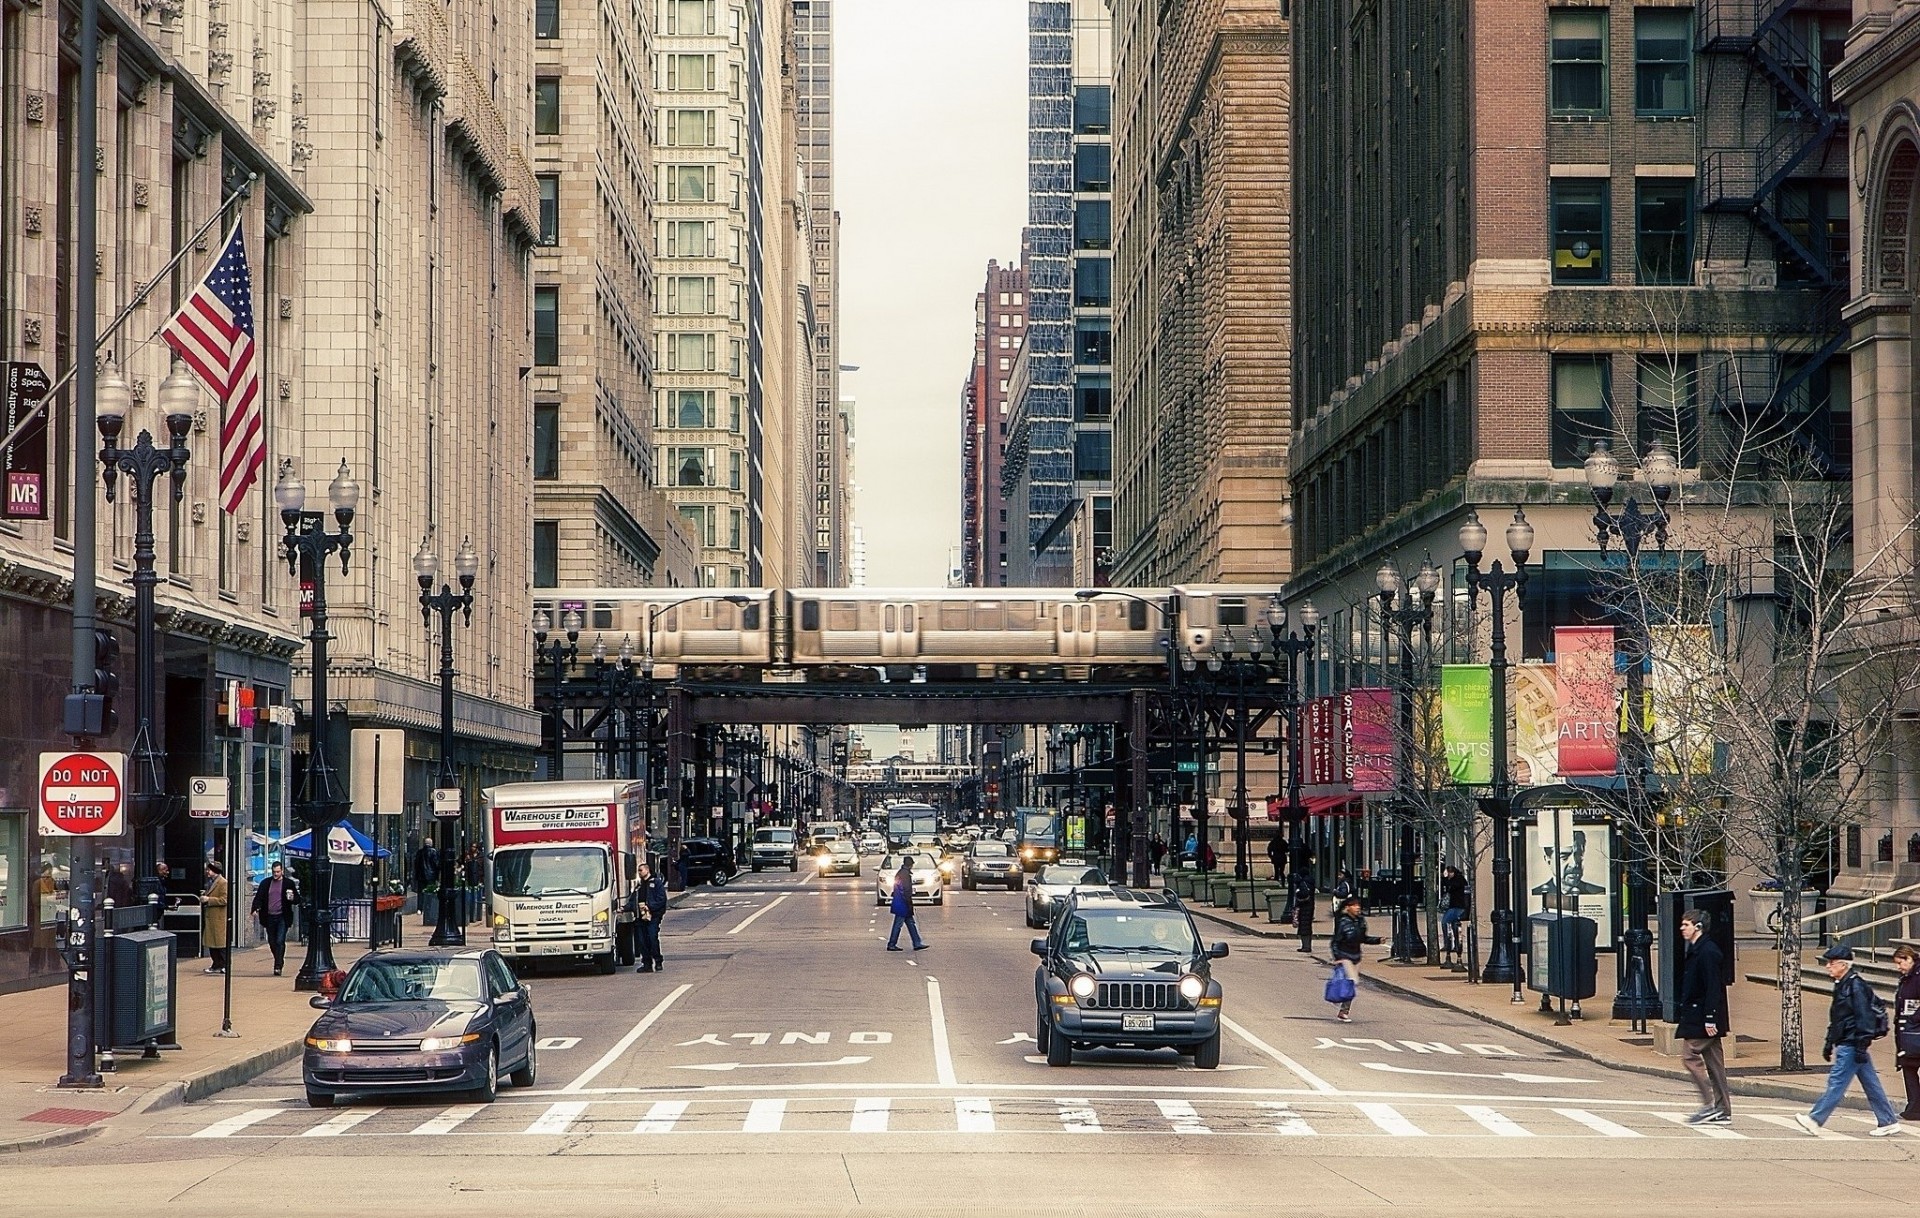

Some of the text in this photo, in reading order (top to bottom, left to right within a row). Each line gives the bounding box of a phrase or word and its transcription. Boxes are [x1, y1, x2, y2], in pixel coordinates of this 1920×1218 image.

[6, 367, 18, 470] www.arcrealty.com
[11, 483, 38, 504] MR
[1463, 684, 1489, 692] chicago
[1463, 691, 1489, 699] cultural
[1343, 694, 1354, 780] STAPLES
[1559, 721, 1616, 740] ARTS
[1446, 741, 1490, 757] ARTS
[1353, 753, 1393, 768] ARTS
[53, 769, 110, 782] DO NOT
[58, 805, 103, 819] ENTER
[329, 839, 356, 852] BR
[673, 1031, 894, 1047] ONLY
[1312, 1037, 1527, 1057] ONLY
